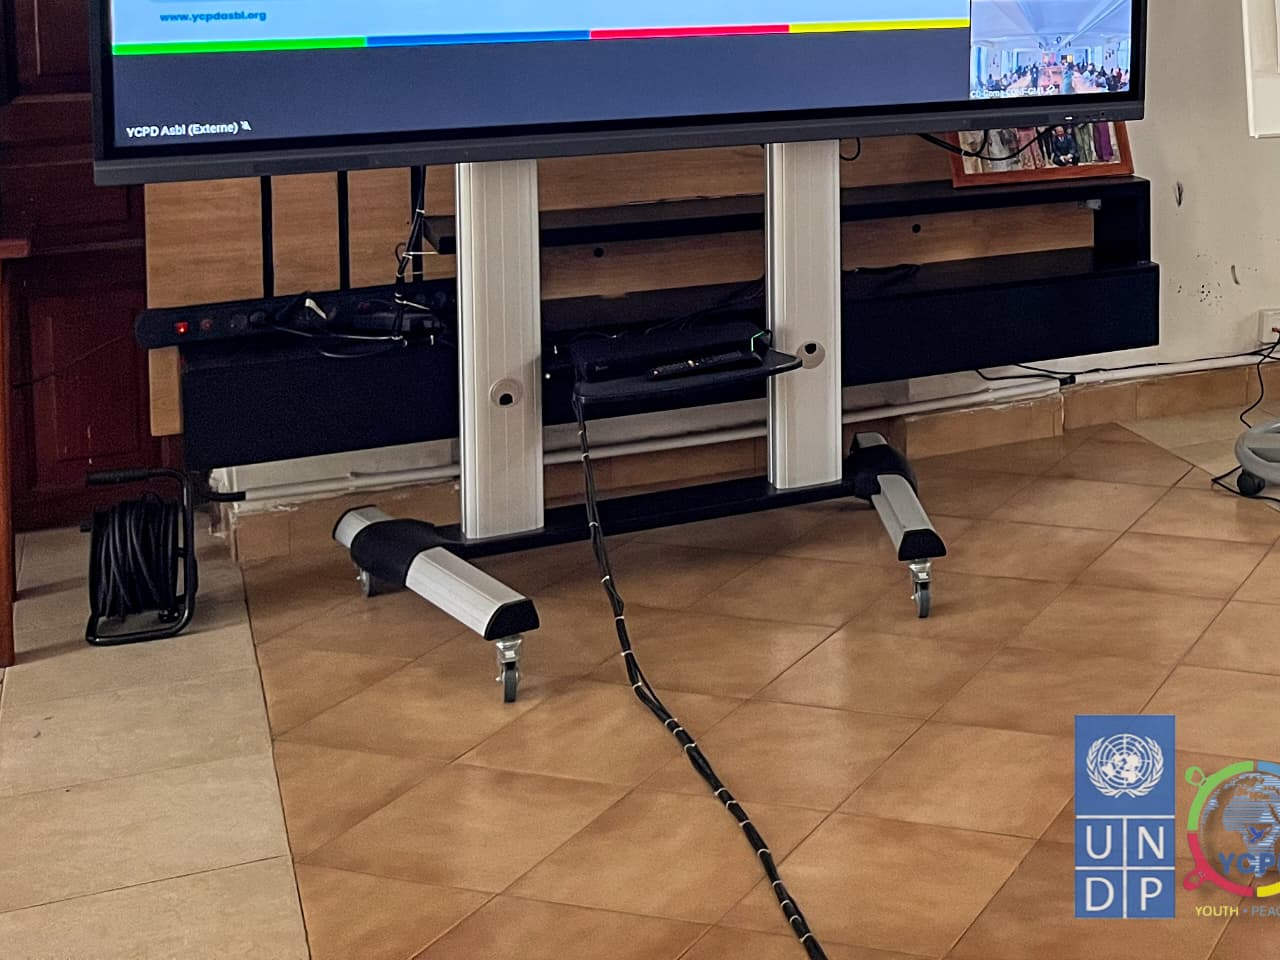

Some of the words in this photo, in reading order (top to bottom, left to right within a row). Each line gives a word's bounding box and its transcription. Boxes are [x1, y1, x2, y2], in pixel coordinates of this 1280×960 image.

[159, 10, 267, 23] www.ycpdasbl.org
[126, 125, 160, 137] YCPD
[160, 124, 186, 136] Asbl
[187, 121, 239, 137] (Externe)
